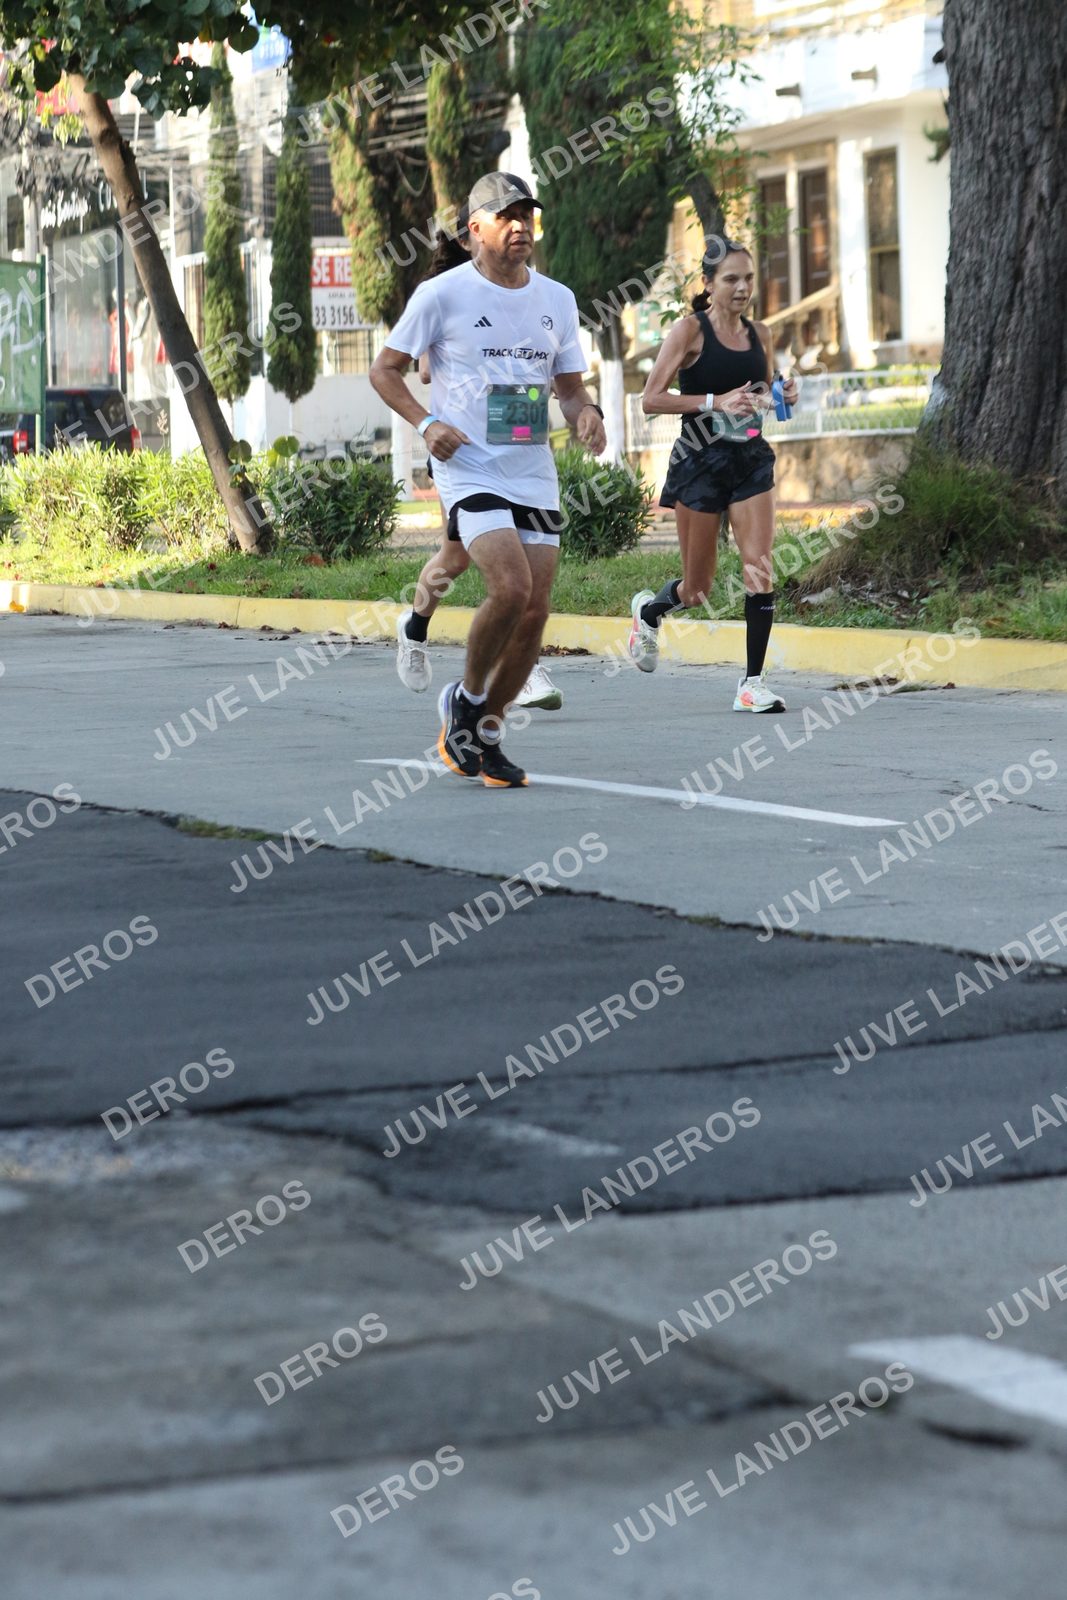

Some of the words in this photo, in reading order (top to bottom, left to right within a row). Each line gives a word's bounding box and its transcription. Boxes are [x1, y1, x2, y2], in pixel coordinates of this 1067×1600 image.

[312, 256, 330, 284] SE
[315, 306, 326, 325] 33
[330, 305, 355, 325] 3156
[482, 348, 513, 357] TRACK
[533, 351, 549, 360] MX
